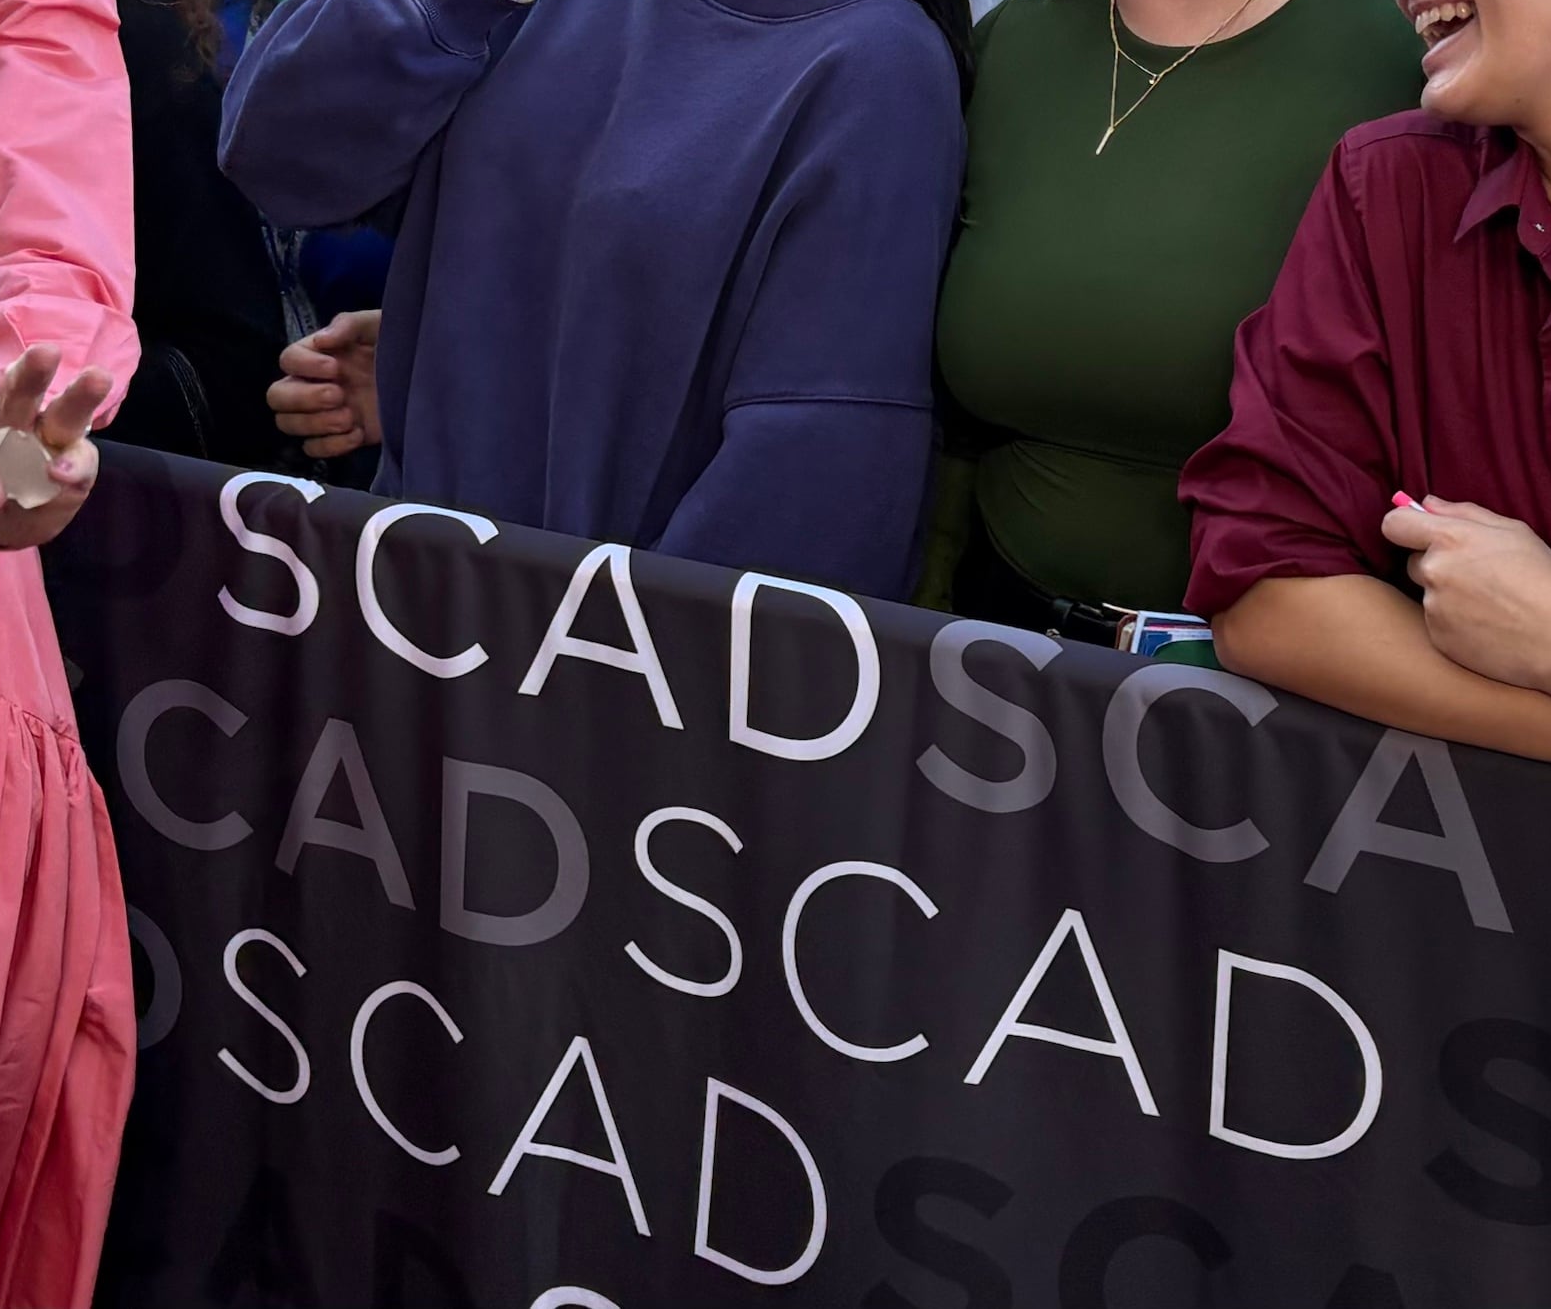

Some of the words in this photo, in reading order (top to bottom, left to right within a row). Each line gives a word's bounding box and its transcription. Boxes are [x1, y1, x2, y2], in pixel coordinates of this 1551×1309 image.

[218, 471, 881, 761] SCAD
[116, 678, 591, 947] CAD
[624, 806, 1383, 1161] SCAD
[217, 927, 829, 1287] SCAD
